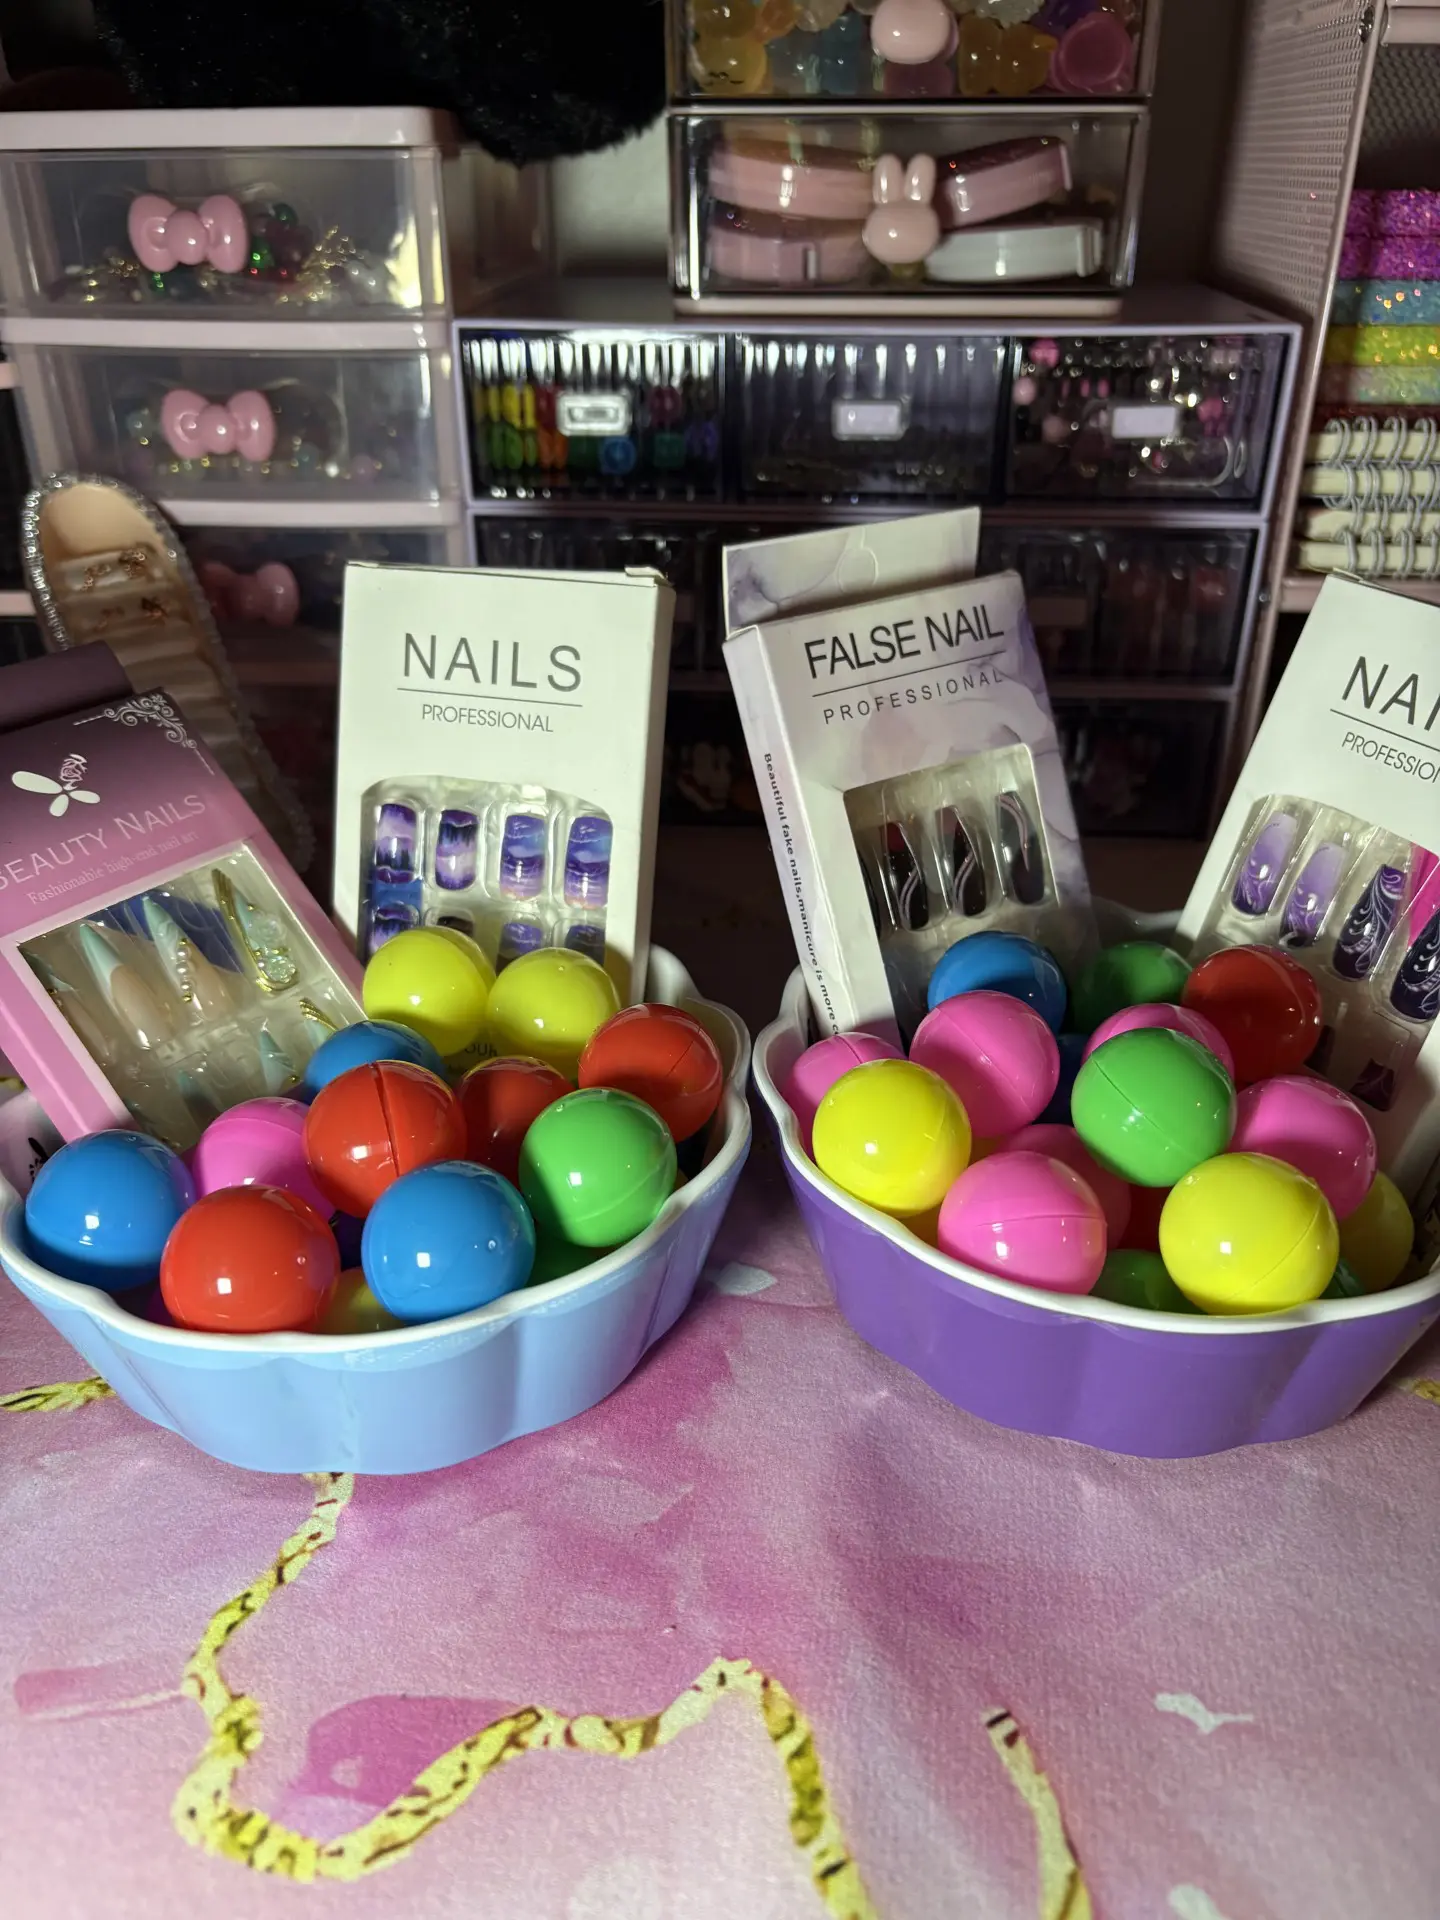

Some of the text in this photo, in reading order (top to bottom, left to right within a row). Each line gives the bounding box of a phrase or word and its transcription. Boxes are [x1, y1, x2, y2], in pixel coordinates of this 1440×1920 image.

[404, 632, 582, 693] NAILS
[804, 604, 1004, 679] FALSE NAIL
[421, 703, 554, 733] PROFESSIONAL
[823, 668, 1004, 725] PROFESSIONAL
[114, 795, 206, 840] NAILS
[26, 830, 200, 905] Fashionable high-end nail art
[763, 753, 787, 821] Beautiful
[781, 824, 794, 855] fake
[815, 969, 824, 981] is
[820, 984, 836, 1020] more
